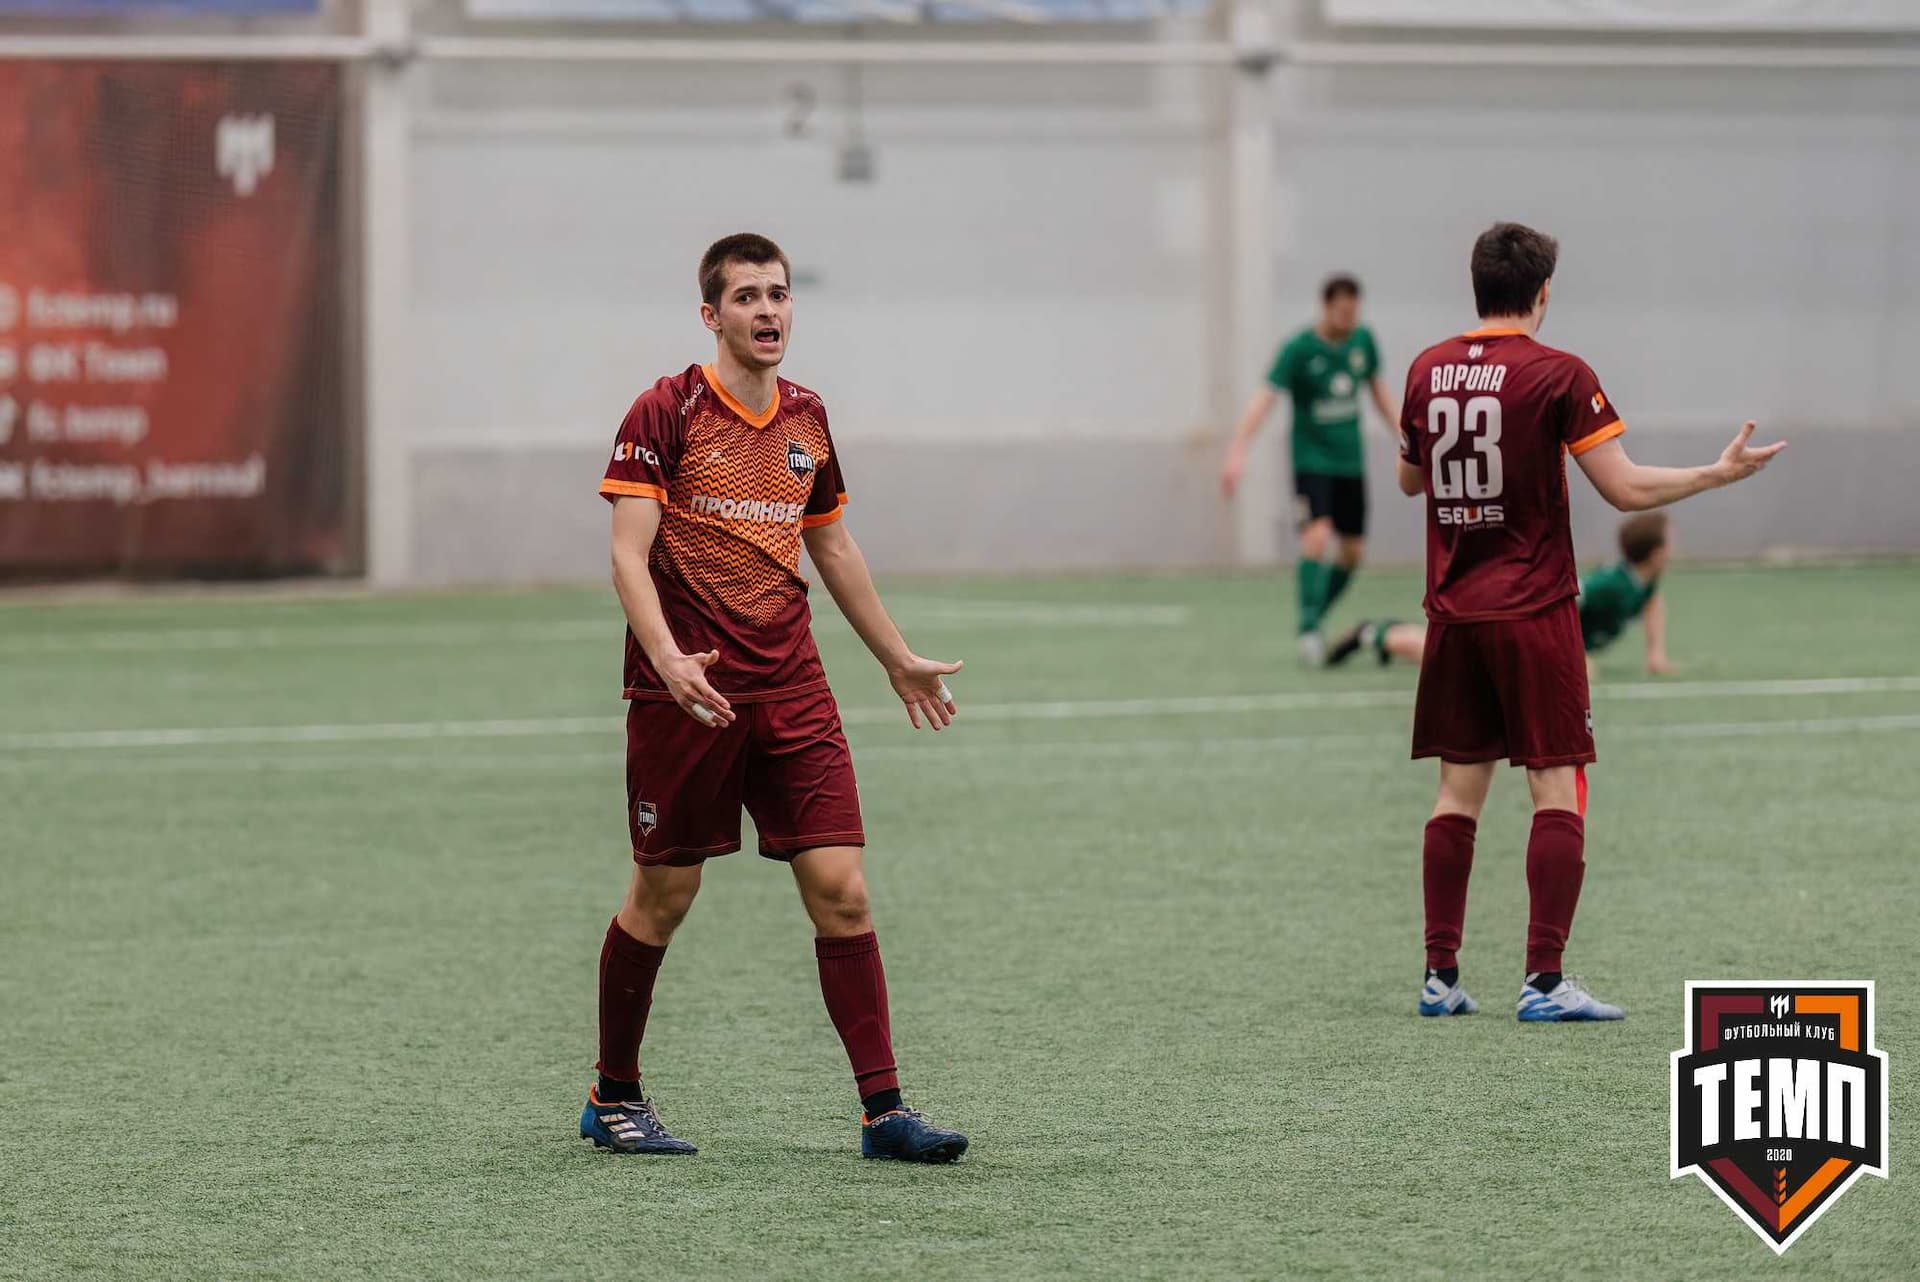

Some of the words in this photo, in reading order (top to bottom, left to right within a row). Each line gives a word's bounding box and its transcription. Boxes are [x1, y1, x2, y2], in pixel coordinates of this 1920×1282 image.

[1430, 363, 1507, 394] ВОРОНА
[1427, 396, 1504, 500] 23
[1437, 505, 1504, 525] SEUS
